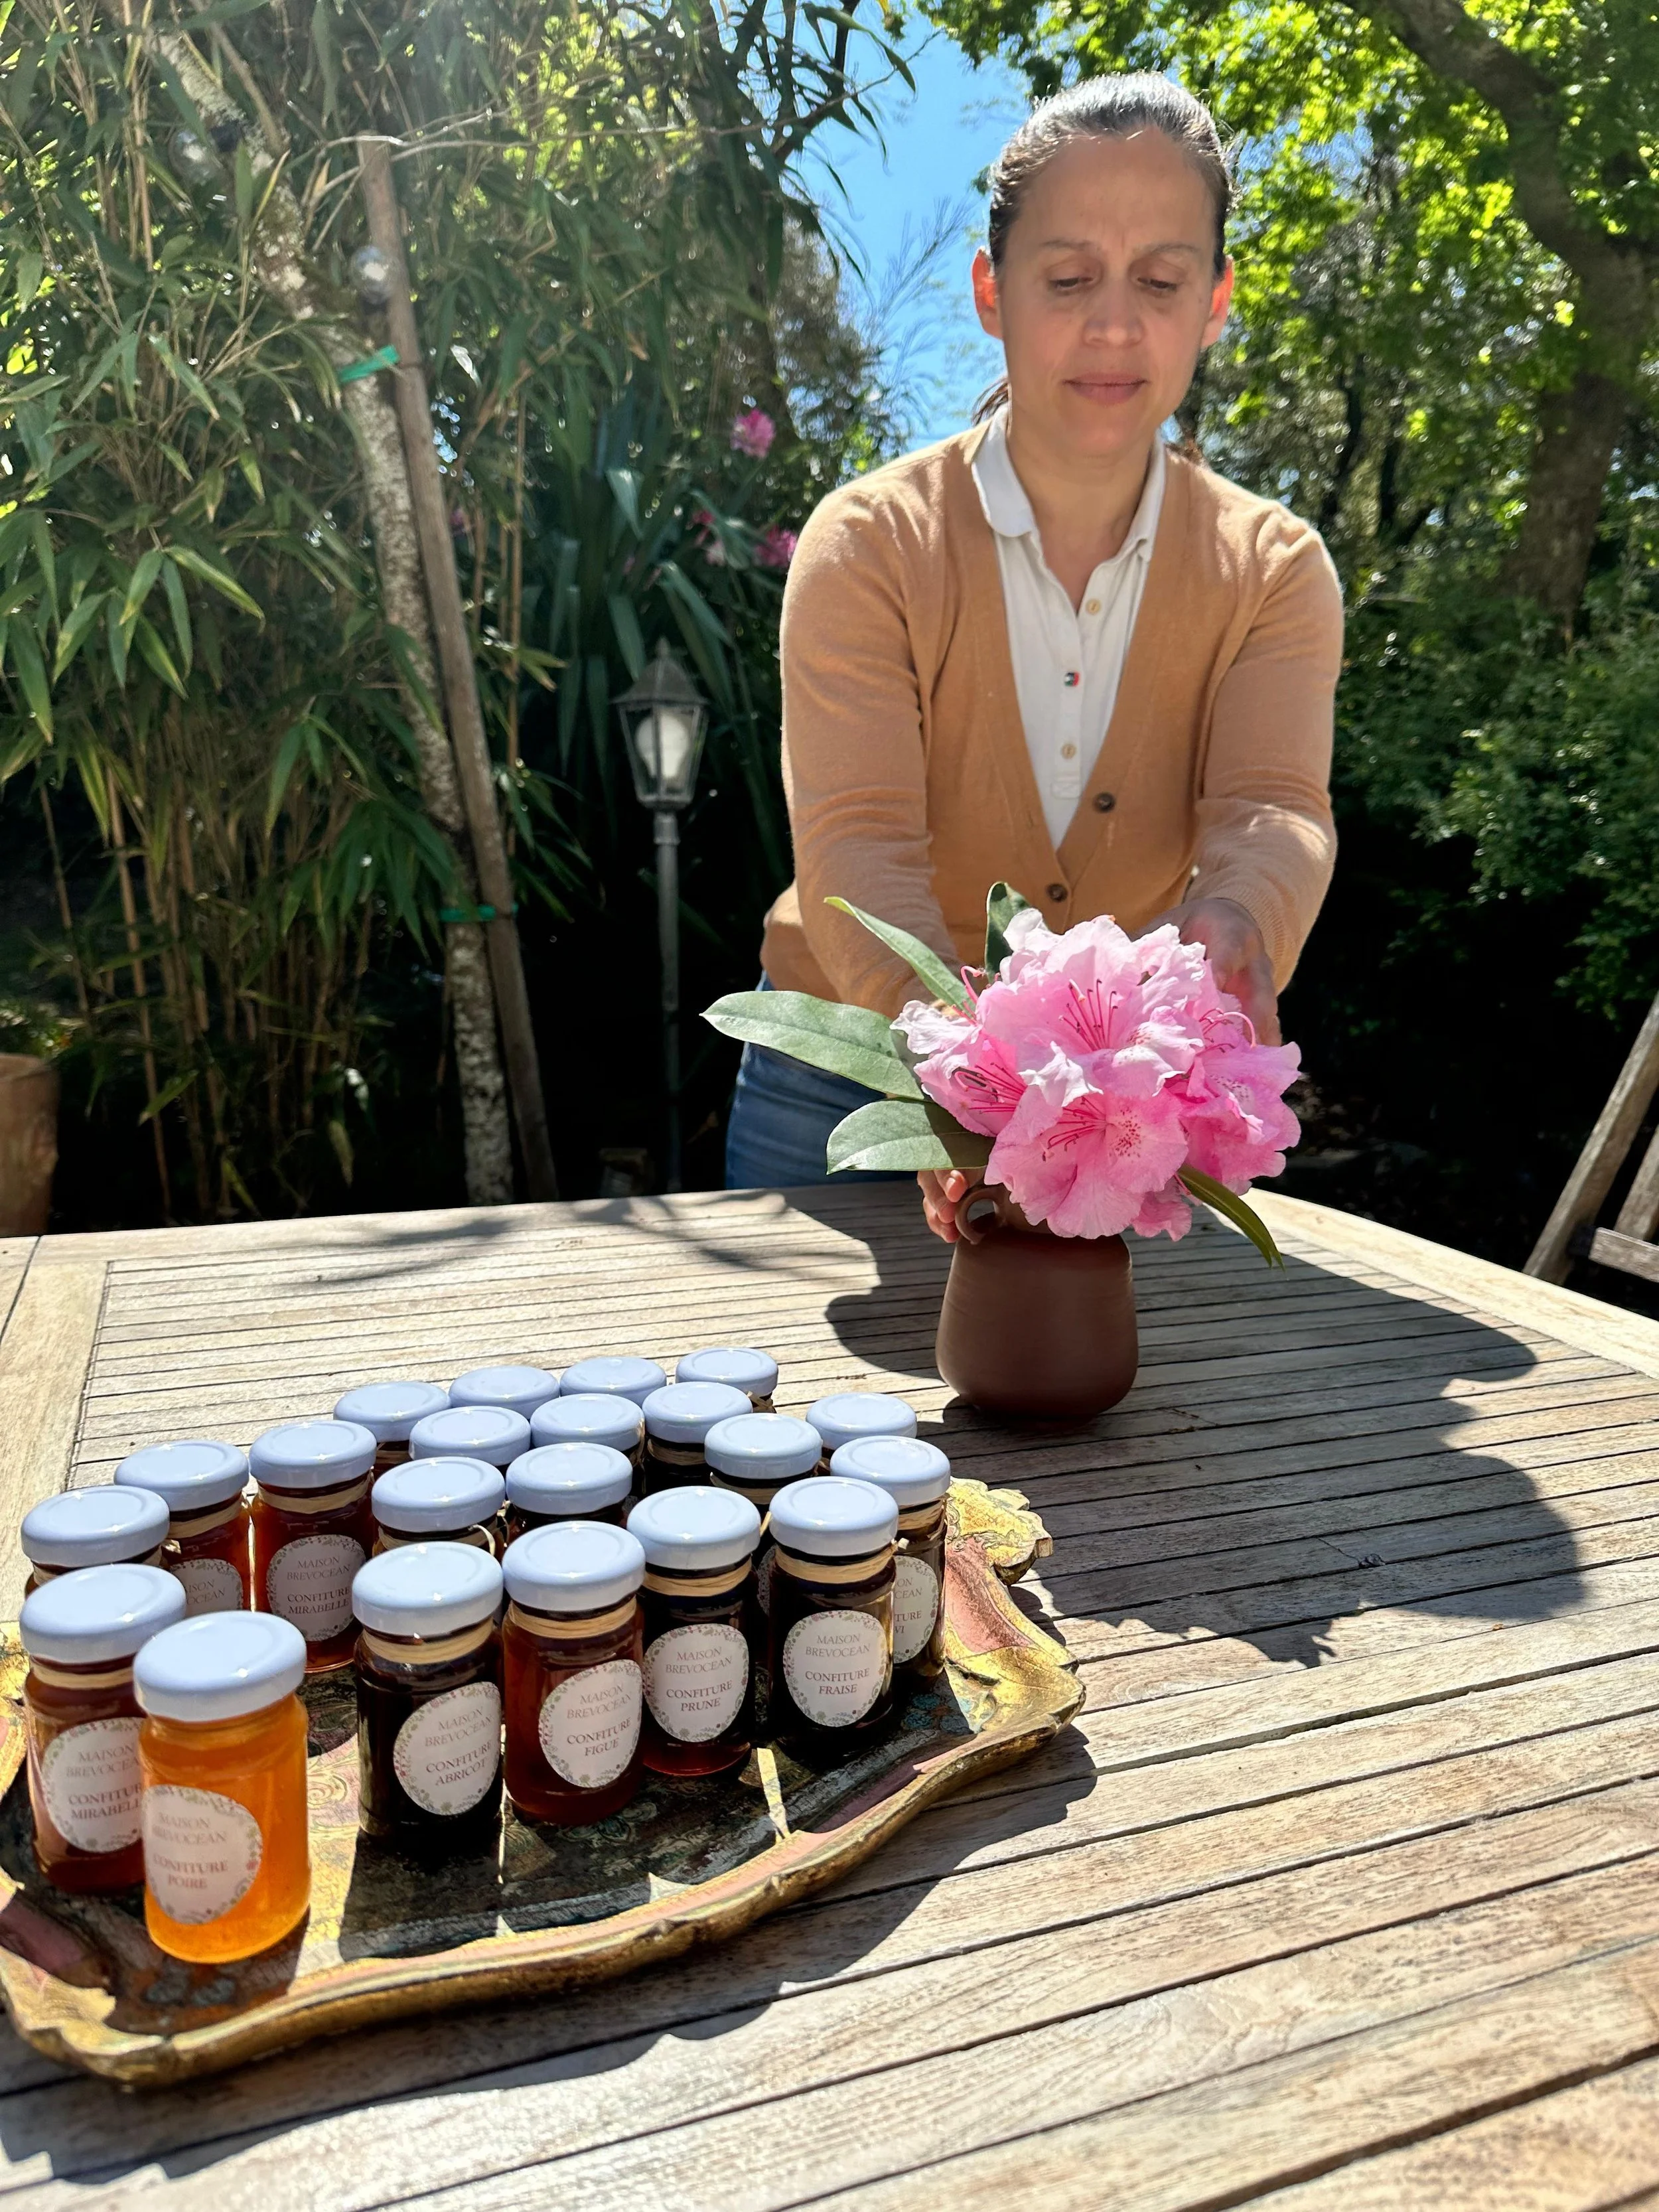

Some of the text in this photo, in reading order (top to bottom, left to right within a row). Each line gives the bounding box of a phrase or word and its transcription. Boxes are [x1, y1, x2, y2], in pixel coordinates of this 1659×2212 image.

[298, 1556, 340, 1569] MAISON
[287, 1564, 350, 1581] BREVOCEAN
[188, 1579, 214, 1593] ISON
[287, 1586, 350, 1603] CONFITURE
[186, 1587, 226, 1605] OCEAN
[288, 1598, 349, 1615] MIRABELLE
[816, 1633, 861, 1645] MAISON
[677, 1646, 722, 1660] MAISON
[805, 1643, 870, 1657] BREVOCEAN
[666, 1655, 733, 1674] BREVOCEAN
[805, 1668, 870, 1682] CONFITURE
[579, 1682, 624, 1705] MAISON
[666, 1680, 733, 1699] CONFITURE
[818, 1684, 857, 1695] FRAISE
[567, 1692, 632, 1720] BREVOCEAN
[681, 1697, 721, 1712] PRUNE
[438, 1706, 484, 1731] MAISON
[425, 1714, 494, 1747] BREVOCEAN
[567, 1717, 631, 1745] CONFITURE
[78, 1741, 135, 1762] MAISON
[426, 1739, 492, 1773] CONFITURE
[585, 1737, 620, 1757] FIGUE
[66, 1756, 141, 1778] BREVOCEA
[435, 1757, 488, 1786] ABRICOT
[68, 1783, 142, 1805] CONFITUR
[70, 1798, 141, 1820] MIRABELL
[159, 1812, 211, 1828] MAISON
[168, 1874, 208, 1889] POIRE
